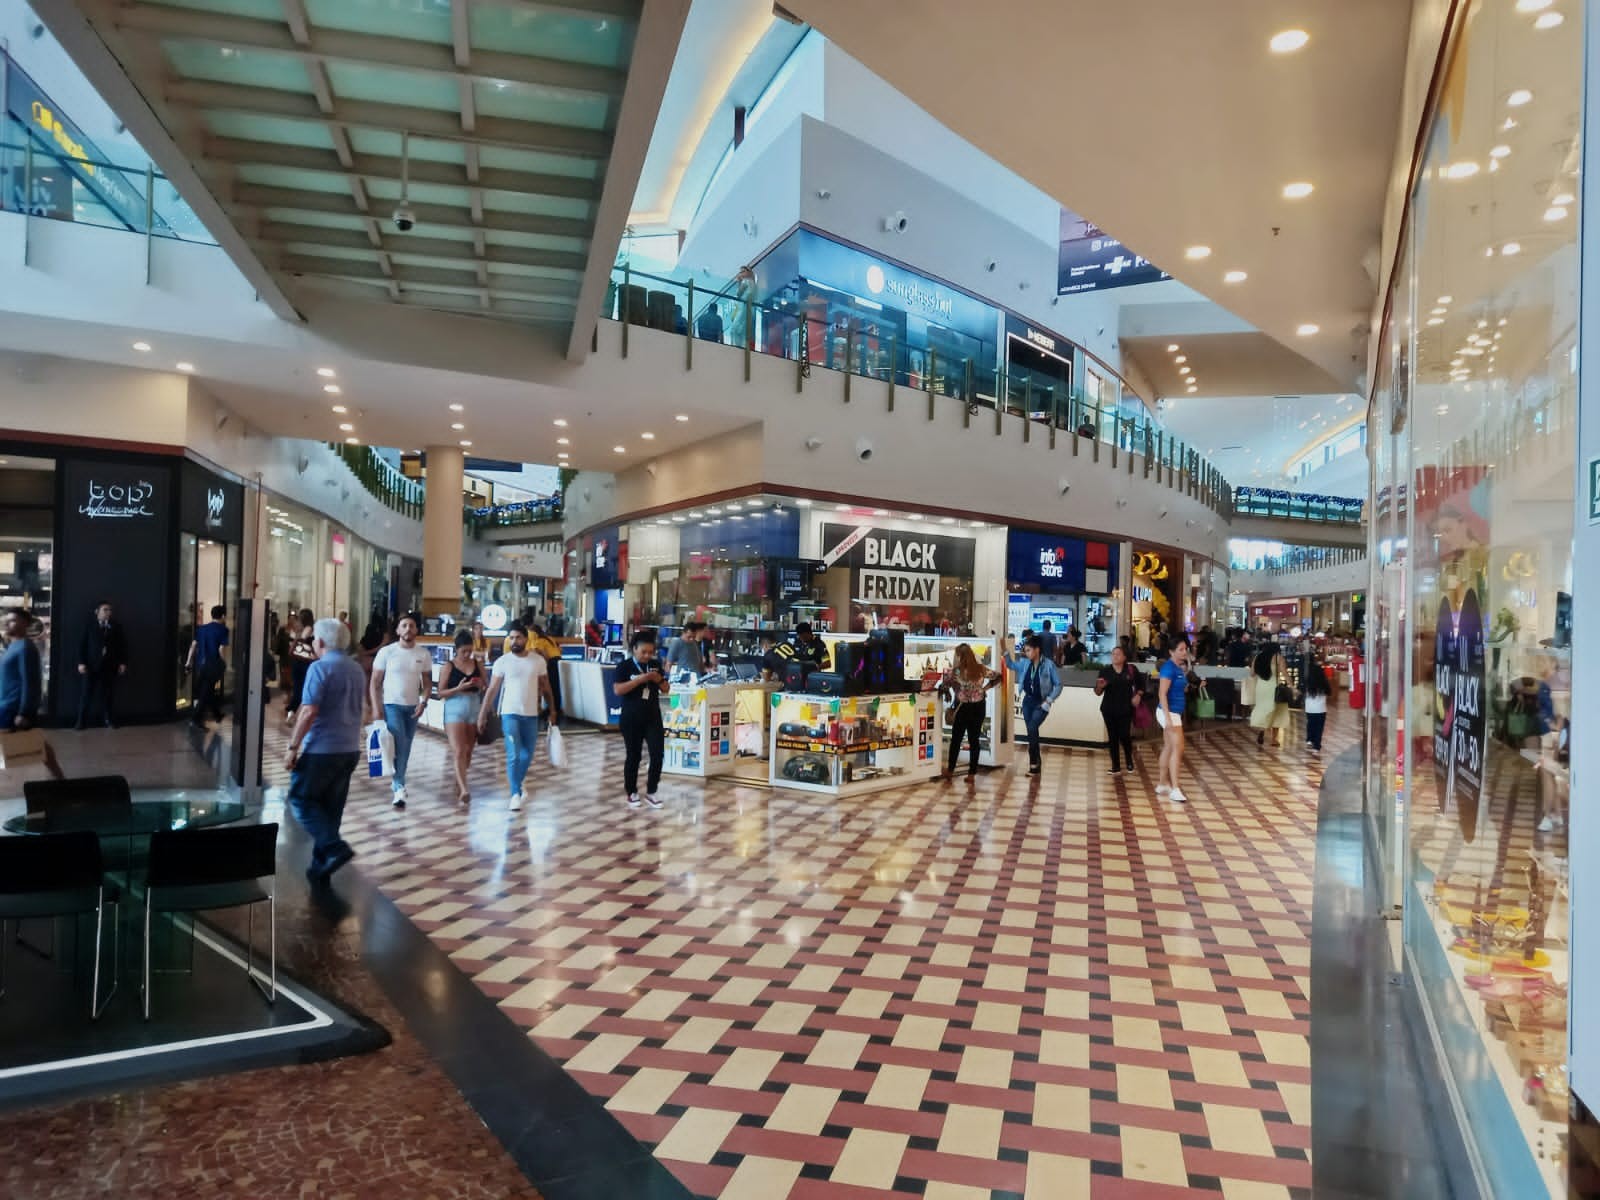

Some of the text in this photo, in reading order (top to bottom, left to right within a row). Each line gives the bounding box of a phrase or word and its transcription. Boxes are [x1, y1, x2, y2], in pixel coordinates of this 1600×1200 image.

[887, 280, 936, 306] sunglass
[864, 537, 937, 570] BLACK
[1040, 547, 1056, 564] info
[1041, 564, 1063, 578] store
[864, 574, 935, 602] FRIDAY
[774, 643, 795, 660] 10
[1458, 674, 1479, 718] BLACK
